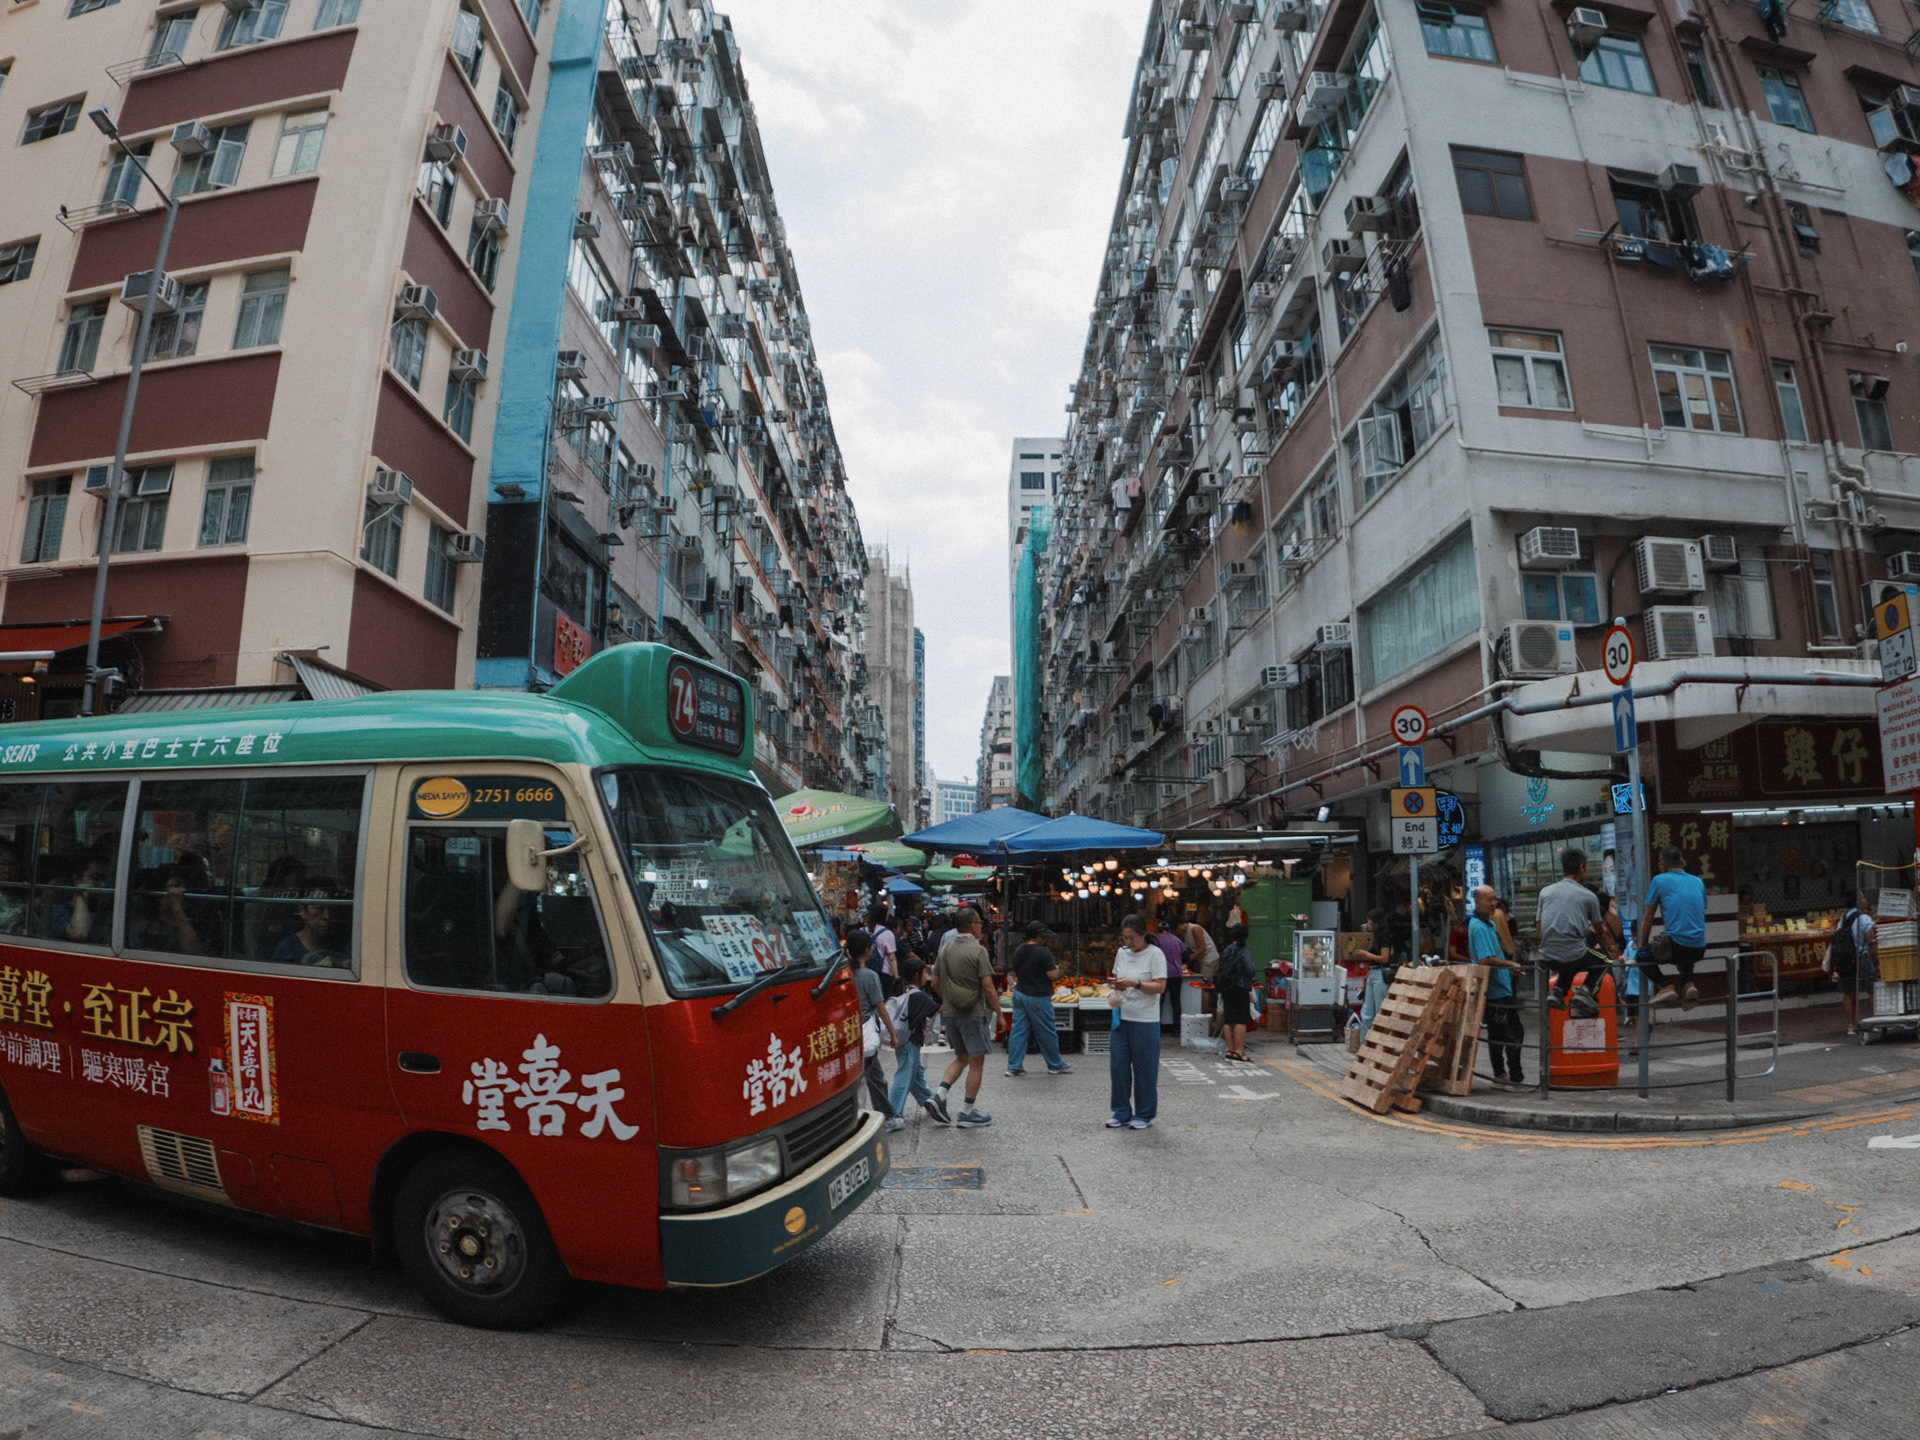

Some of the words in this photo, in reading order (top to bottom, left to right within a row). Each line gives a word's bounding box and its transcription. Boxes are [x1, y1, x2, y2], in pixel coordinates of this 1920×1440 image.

[1899, 634, 1905, 649] 7
[1608, 643, 1629, 669] 30
[1903, 656, 1914, 672] 12
[673, 678, 694, 724] 74
[1891, 686, 1913, 699] Vehicle
[1883, 700, 1905, 713] waiting
[1905, 695, 1917, 705] will
[1397, 718, 1422, 734] 30
[1882, 723, 1905, 735] without
[1906, 719, 1920, 729] warn
[2, 743, 40, 764] SEATS
[63, 732, 283, 762] 公共小型巴士十六座位
[1783, 727, 1869, 786] 雞仔
[1893, 750, 1920, 769] 會被檢
[416, 793, 441, 801] MEDIA
[442, 792, 467, 800] SAVVY
[474, 789, 510, 803] 2751
[516, 788, 554, 802] 6666
[1405, 822, 1425, 832] End
[1652, 820, 1729, 850] 雞仔餅
[1401, 836, 1429, 849] 終止
[768, 931, 793, 966] 74
[81, 1047, 170, 1098] 驅寒暖宮
[240, 1022, 264, 1109] 天喜丸
[845, 1160, 869, 1193] 9022
